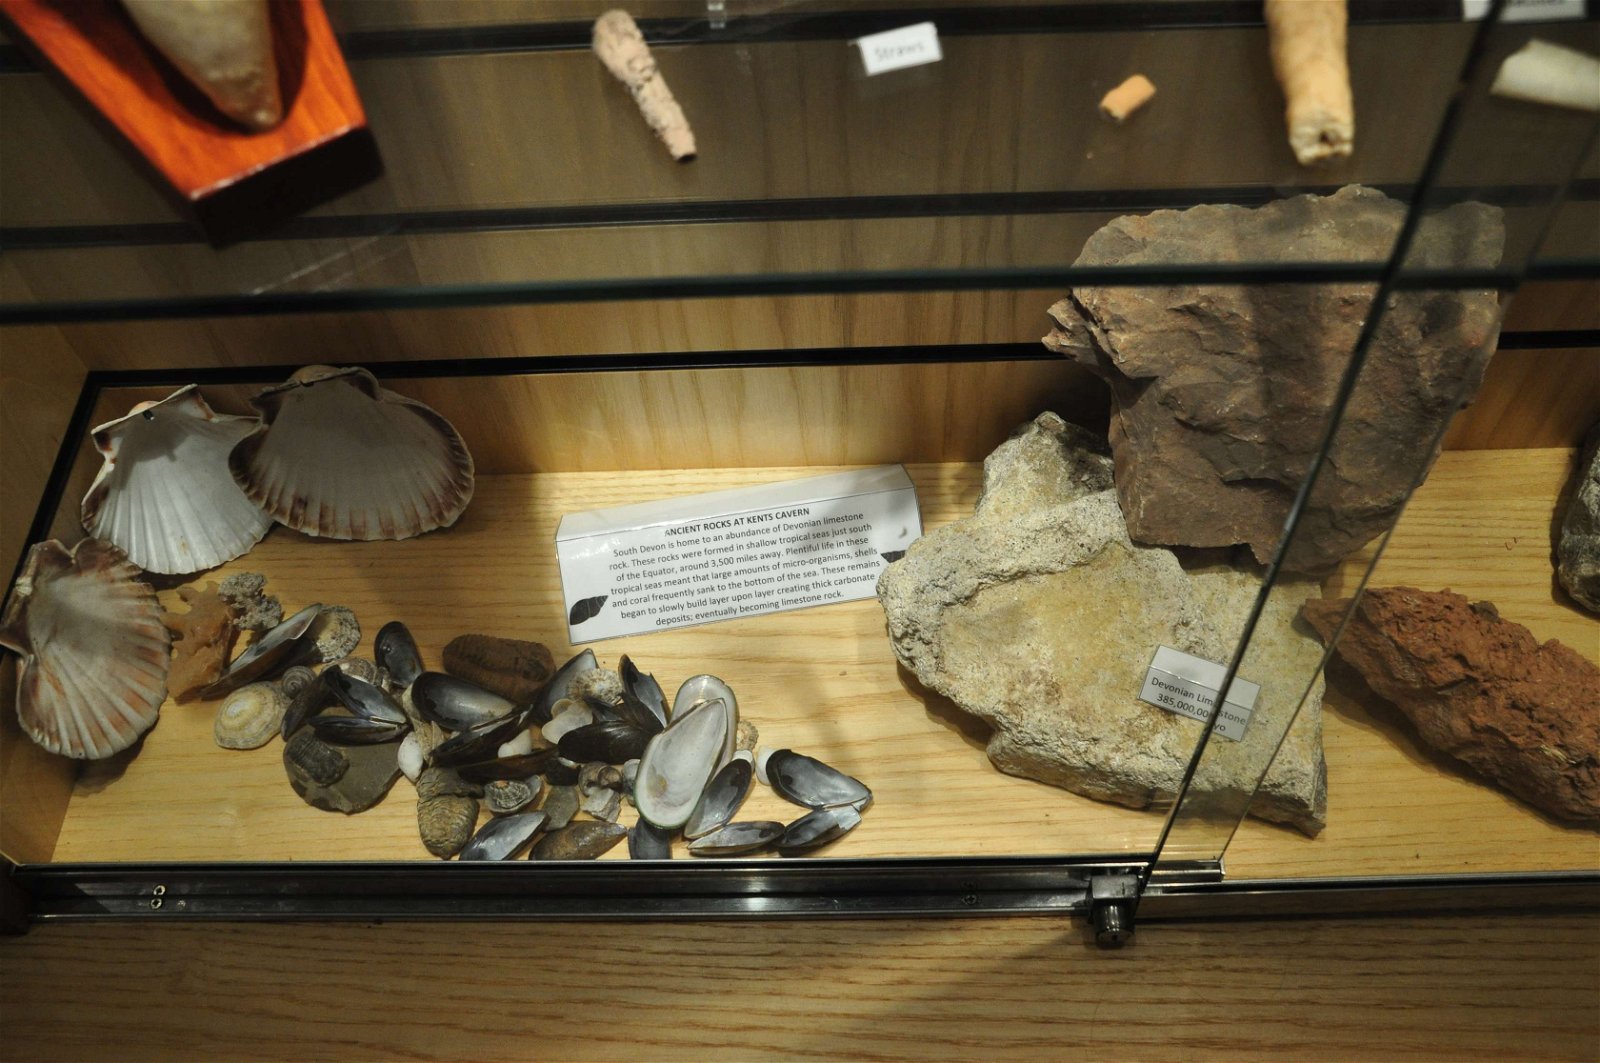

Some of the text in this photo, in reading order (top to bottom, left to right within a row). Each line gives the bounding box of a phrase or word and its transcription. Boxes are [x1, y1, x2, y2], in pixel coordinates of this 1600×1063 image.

[613, 546, 637, 557] South
[640, 543, 666, 553] Devon
[677, 538, 700, 547] home
[726, 528, 770, 539] abundance
[773, 524, 781, 532] of
[783, 519, 821, 531] Devonian
[824, 513, 864, 524] limestone
[665, 508, 810, 536] ANCIENT ROCKS AT KENTS CAVERN
[610, 561, 629, 570] rock.
[631, 558, 655, 567] These
[658, 552, 679, 563] rocks
[682, 551, 702, 559] were
[705, 544, 734, 555] formed
[746, 538, 780, 549] shallow
[780, 533, 810, 545] tropical
[832, 528, 846, 538] just
[849, 524, 872, 533] south
[627, 572, 640, 580] the
[643, 568, 678, 579] Equator,
[680, 561, 708, 572] around
[711, 557, 734, 568] 3,500
[736, 555, 758, 563] miles
[761, 551, 783, 560] away.
[786, 543, 819, 555] Plentiful
[822, 542, 834, 550] life
[846, 537, 868, 546] these
[611, 582, 642, 595] tropical
[645, 581, 662, 590] seas
[664, 576, 690, 586] meant
[693, 573, 709, 582] that
[712, 570, 731, 580] large
[734, 565, 770, 575] amounts
[783, 553, 852, 569] micro-organisms,
[855, 548, 877, 557] shells
[612, 598, 627, 607] and
[630, 594, 650, 605] coral
[652, 588, 694, 602] frequently
[697, 585, 715, 594] sank
[745, 577, 778, 587] bottom
[787, 571, 800, 580] the
[803, 570, 819, 578] sea.
[821, 566, 845, 575] These
[848, 560, 880, 571] remains
[621, 574, 875, 618] began to slowly build layer upon layer creating thick carbonate
[696, 606, 737, 620] eventually
[740, 599, 780, 612] becoming
[782, 594, 821, 606] limestone
[824, 590, 844, 599] rock.
[1151, 676, 1246, 725] Devonian Limstone
